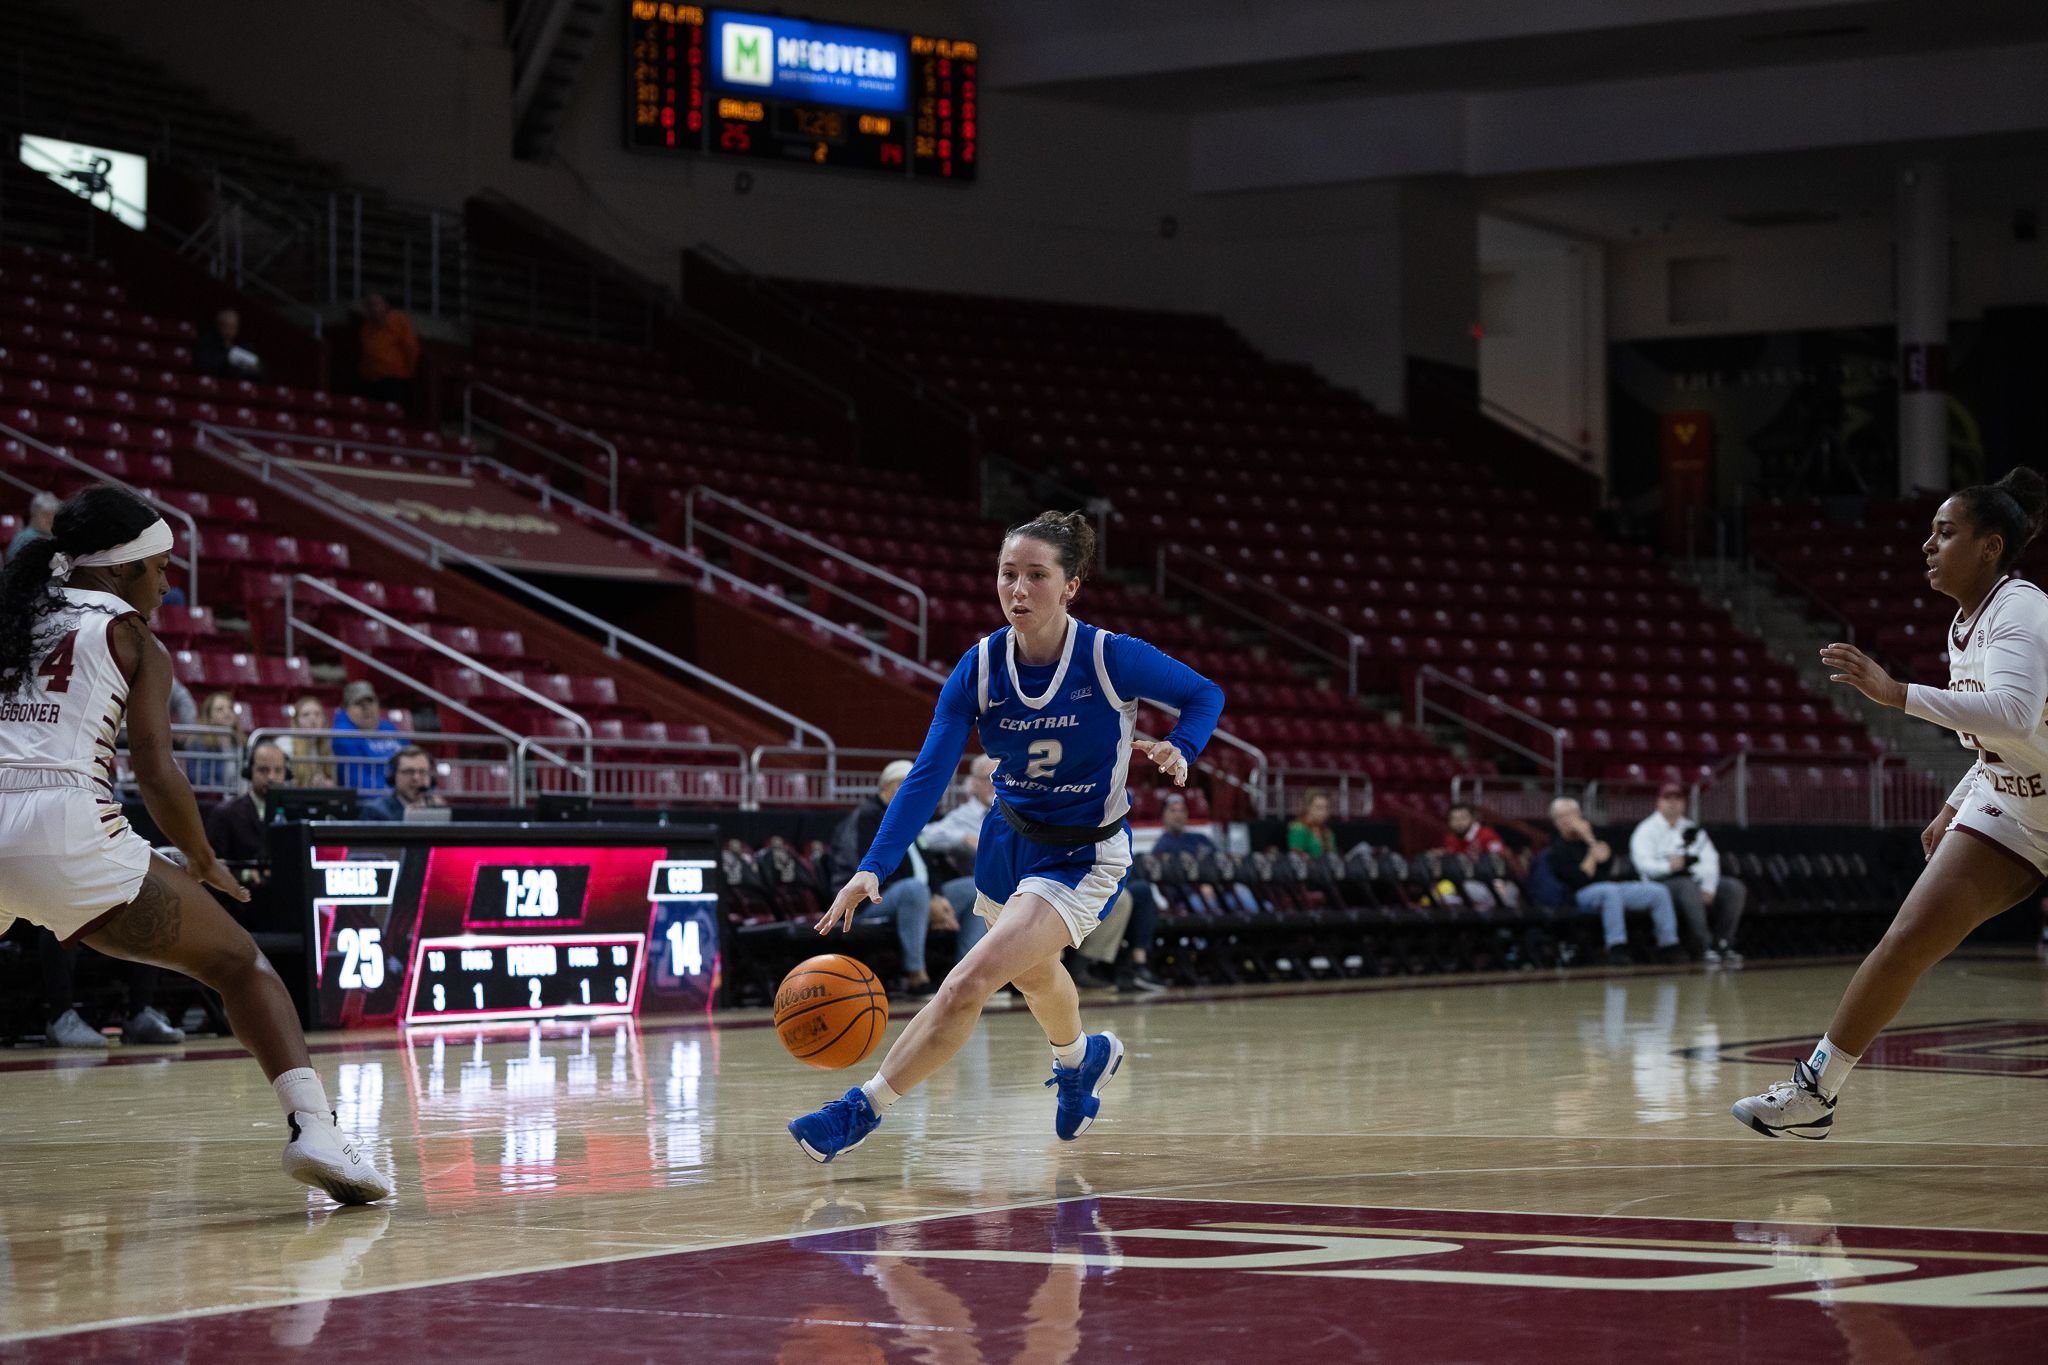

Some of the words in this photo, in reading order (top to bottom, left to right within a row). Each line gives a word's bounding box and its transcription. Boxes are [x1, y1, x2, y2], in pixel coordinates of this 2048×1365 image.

[734, 35, 760, 75] M
[1949, 678, 1985, 692] OSTON
[0, 703, 60, 723] GGONER
[1000, 715, 1079, 731] CENTRAL
[1024, 739, 1063, 779] 2
[502, 869, 559, 917] 7:28
[337, 928, 385, 989] 25
[666, 921, 702, 976] 14
[473, 982, 485, 1009] 1
[528, 977, 542, 1009] 2
[580, 978, 591, 1004] 1
